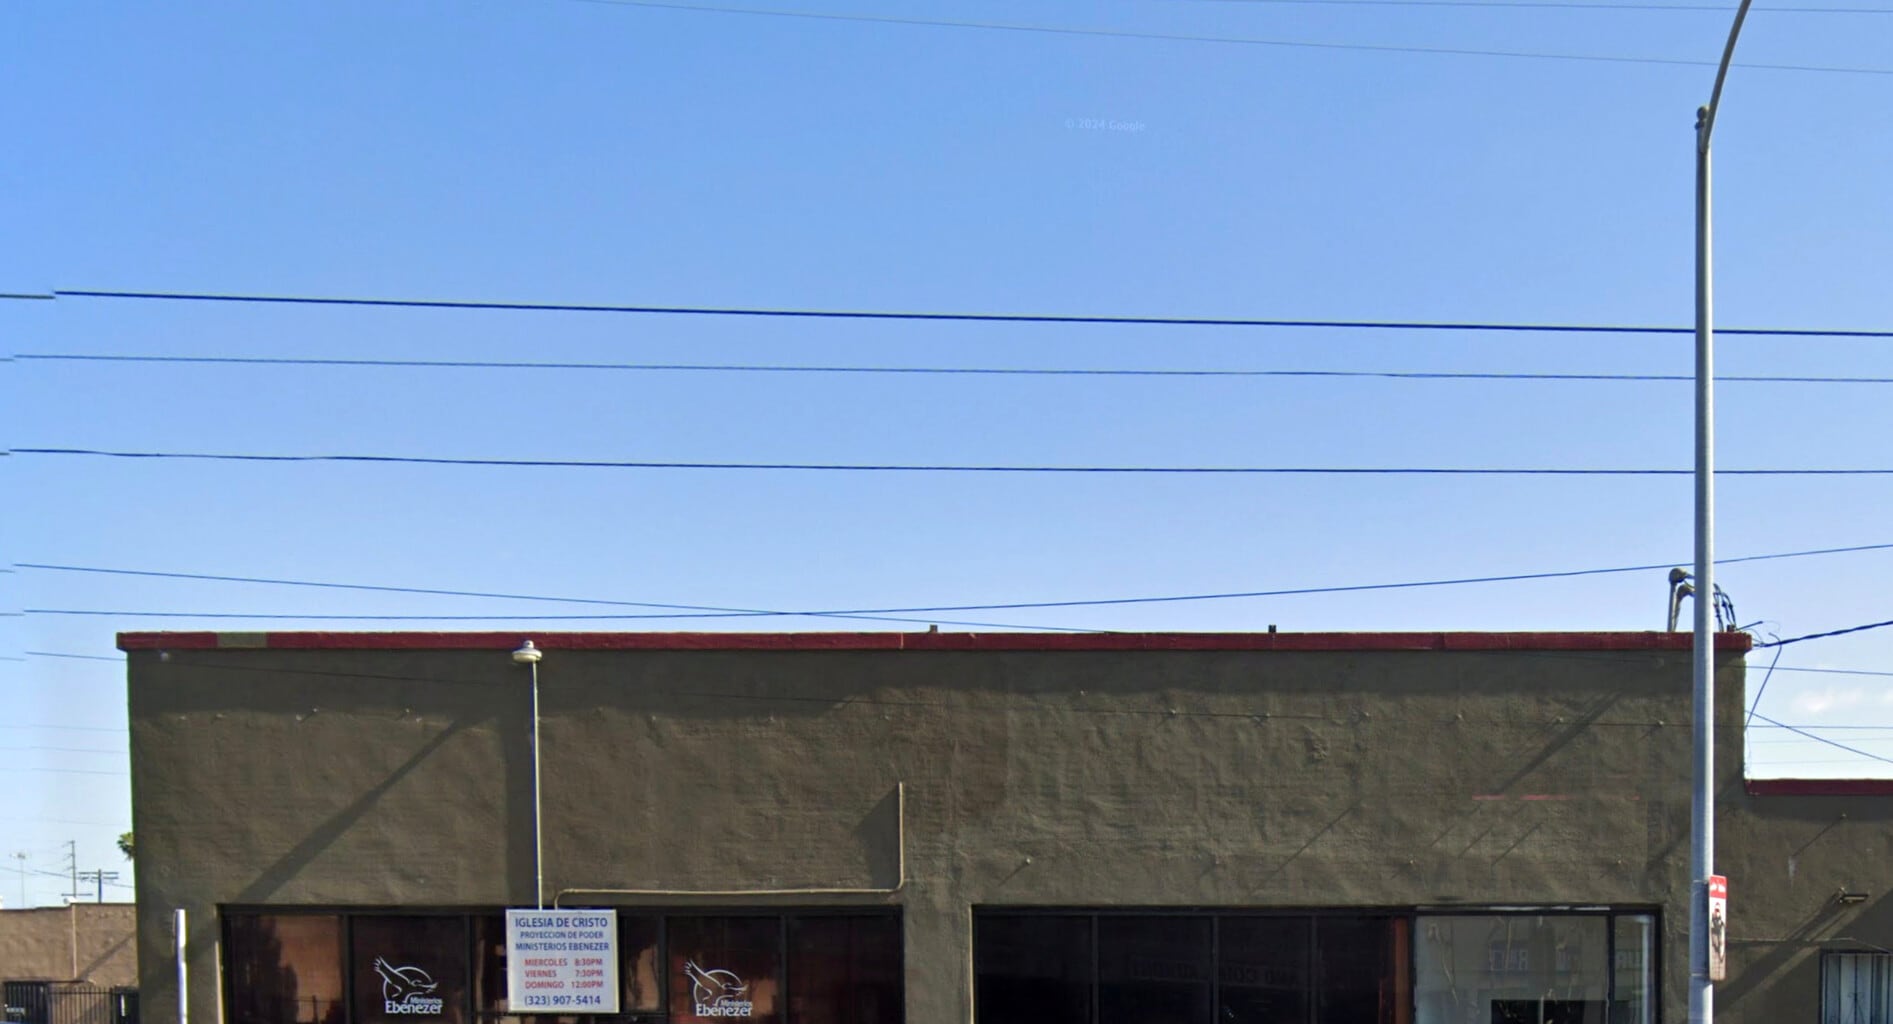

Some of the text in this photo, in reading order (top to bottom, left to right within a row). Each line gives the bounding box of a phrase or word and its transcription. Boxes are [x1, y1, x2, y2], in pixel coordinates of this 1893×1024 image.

[515, 917, 608, 928] IGLESIA DE CRISTO
[520, 931, 604, 939] PROYECCION DE PODER
[515, 942, 609, 951] MINISTERIOS EBENEZER
[524, 958, 568, 967] MIERCOLES
[524, 969, 604, 978] VIERNES 7:30PM
[525, 980, 604, 990] DOMINGO 12:00PM
[524, 995, 601, 1006] (323) 907-5414
[385, 1000, 443, 1014] Ebenezer
[695, 1003, 753, 1017] Ebenezer
